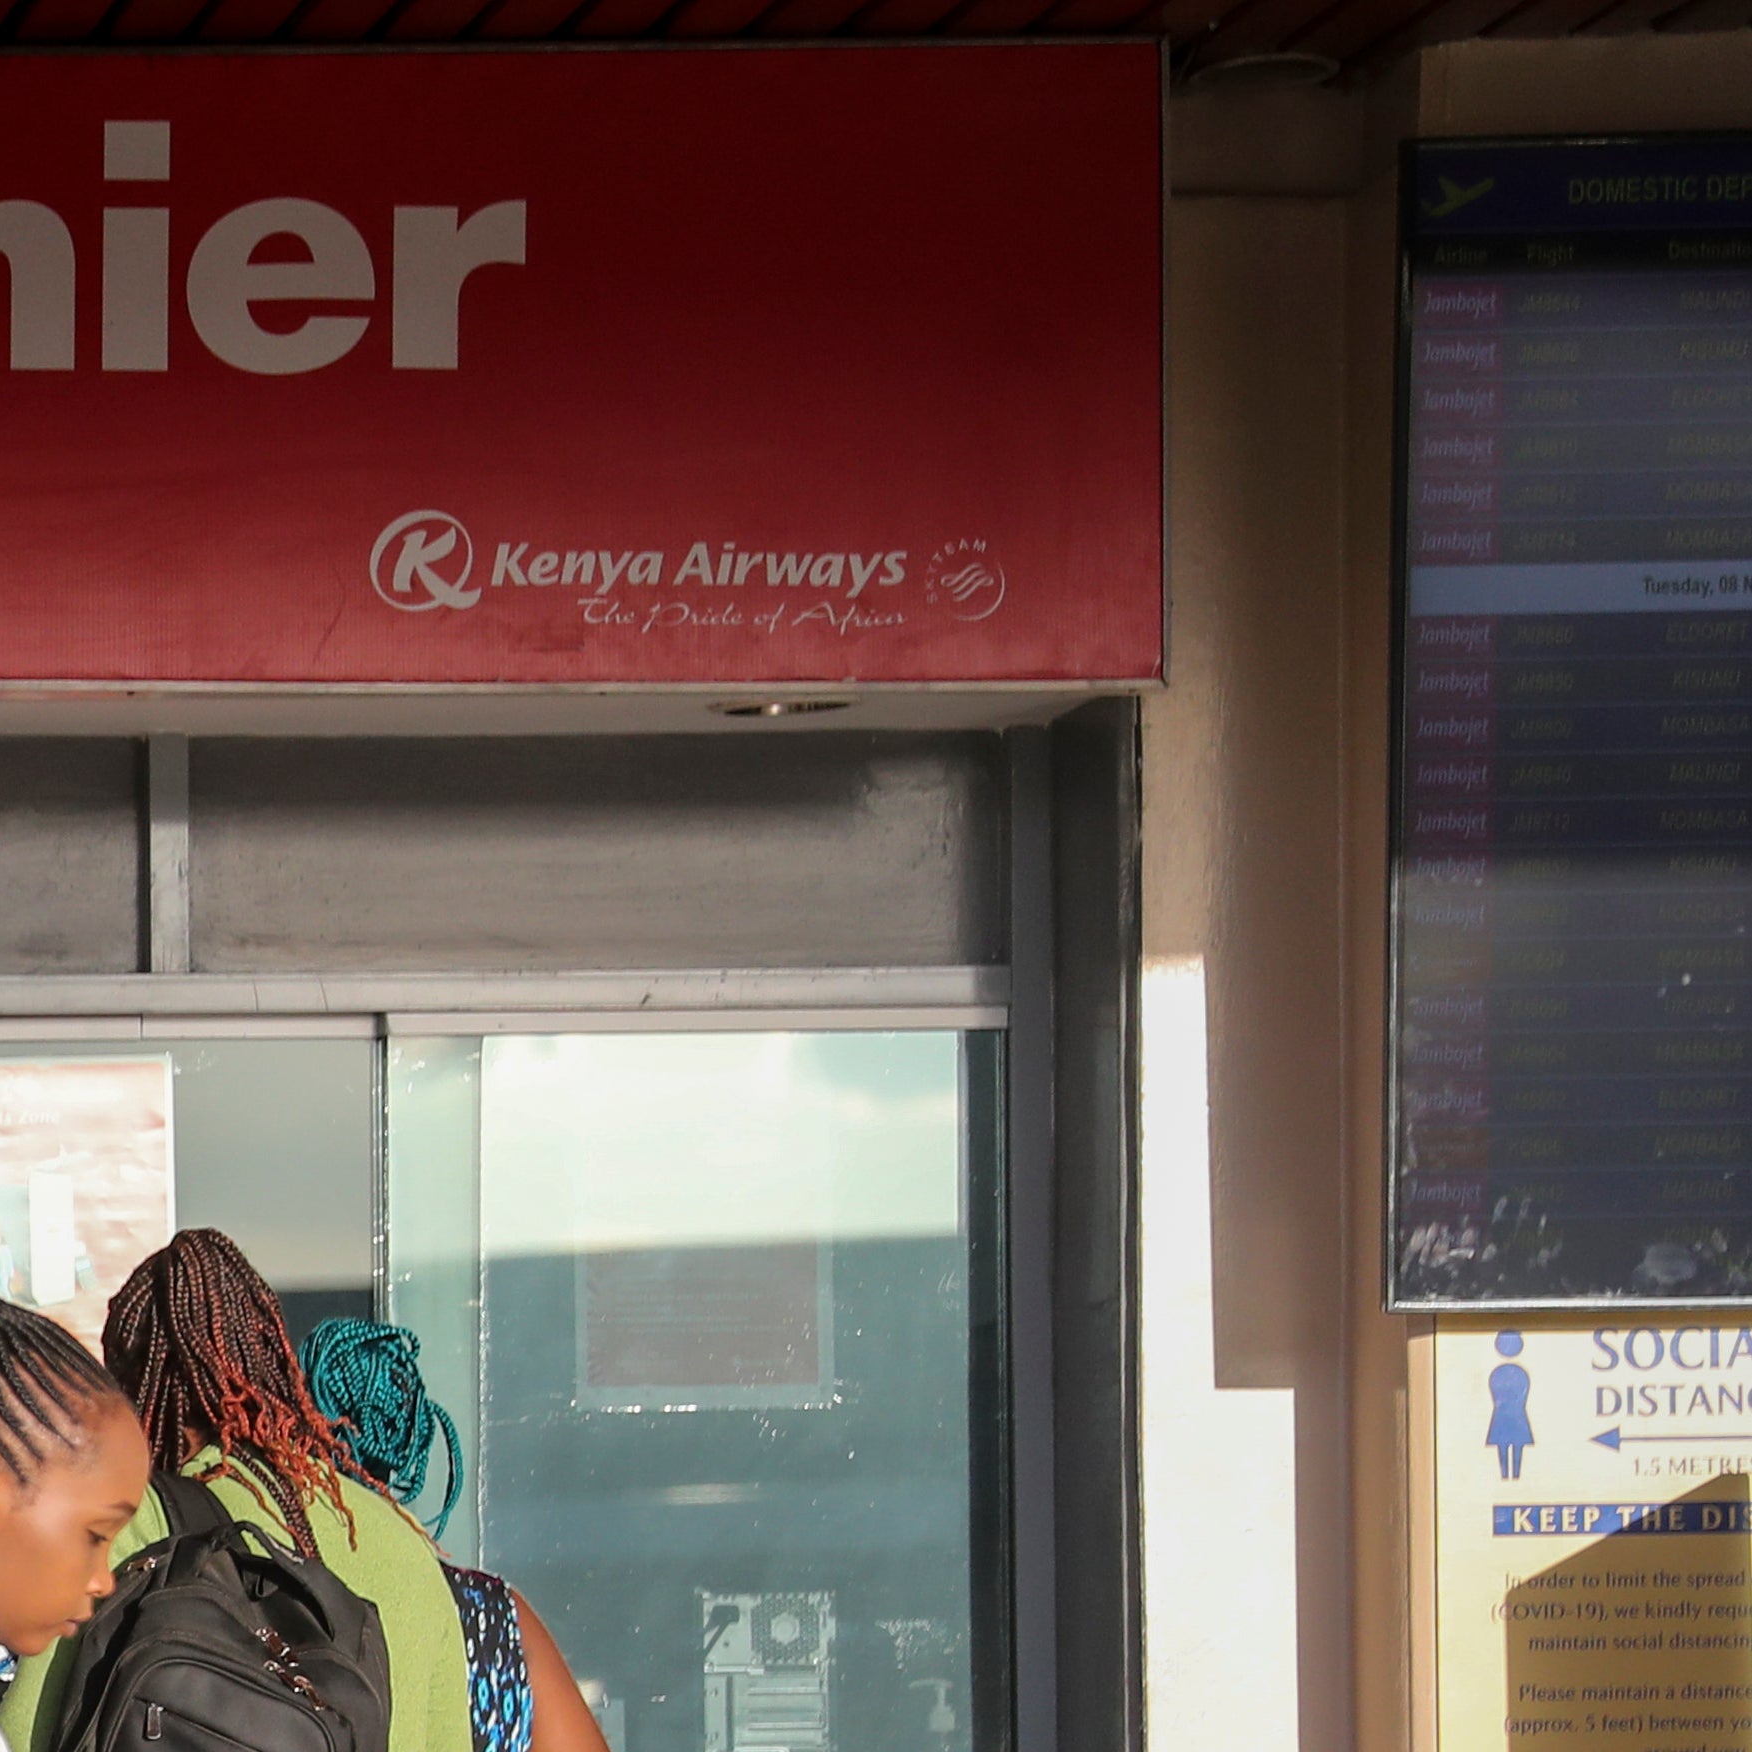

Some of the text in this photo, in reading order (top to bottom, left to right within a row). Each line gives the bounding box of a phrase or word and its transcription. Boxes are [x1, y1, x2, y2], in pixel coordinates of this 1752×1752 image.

[1568, 176, 1698, 205] DOMESTIC
[1424, 290, 1498, 320] Jambojet
[1424, 341, 1497, 370] Jambojet
[1421, 530, 1493, 559] Jambojet
[491, 541, 907, 598] Kenya Airways
[1643, 576, 1713, 600] Tuesday,
[1718, 574, 1738, 594] 08
[577, 598, 906, 634] The Pride of Africa
[1419, 623, 1491, 652] Jambojet
[1418, 670, 1490, 699] Jambojet
[1417, 716, 1489, 745] Jambojet
[1417, 763, 1488, 792] Jambojet
[1416, 810, 1487, 839] Jambojet
[1633, 1458, 1660, 1476] 1.5
[1513, 1506, 1601, 1532] KEEP
[1616, 1505, 1685, 1532] THE
[1505, 1570, 1745, 1592] In order to limit the spread
[1614, 1606, 1639, 1619] we
[1645, 1599, 1701, 1621] kindly
[1529, 1633, 1606, 1650] maintain
[1613, 1632, 1663, 1650] social
[1519, 1684, 1575, 1701] Please
[1581, 1683, 1659, 1701] maintain
[1665, 1686, 1674, 1699] a
[1504, 1716, 1578, 1736] (approx.
[1586, 1716, 1595, 1733] 5
[1602, 1714, 1643, 1736] feet)
[1649, 1714, 1724, 1731] between
